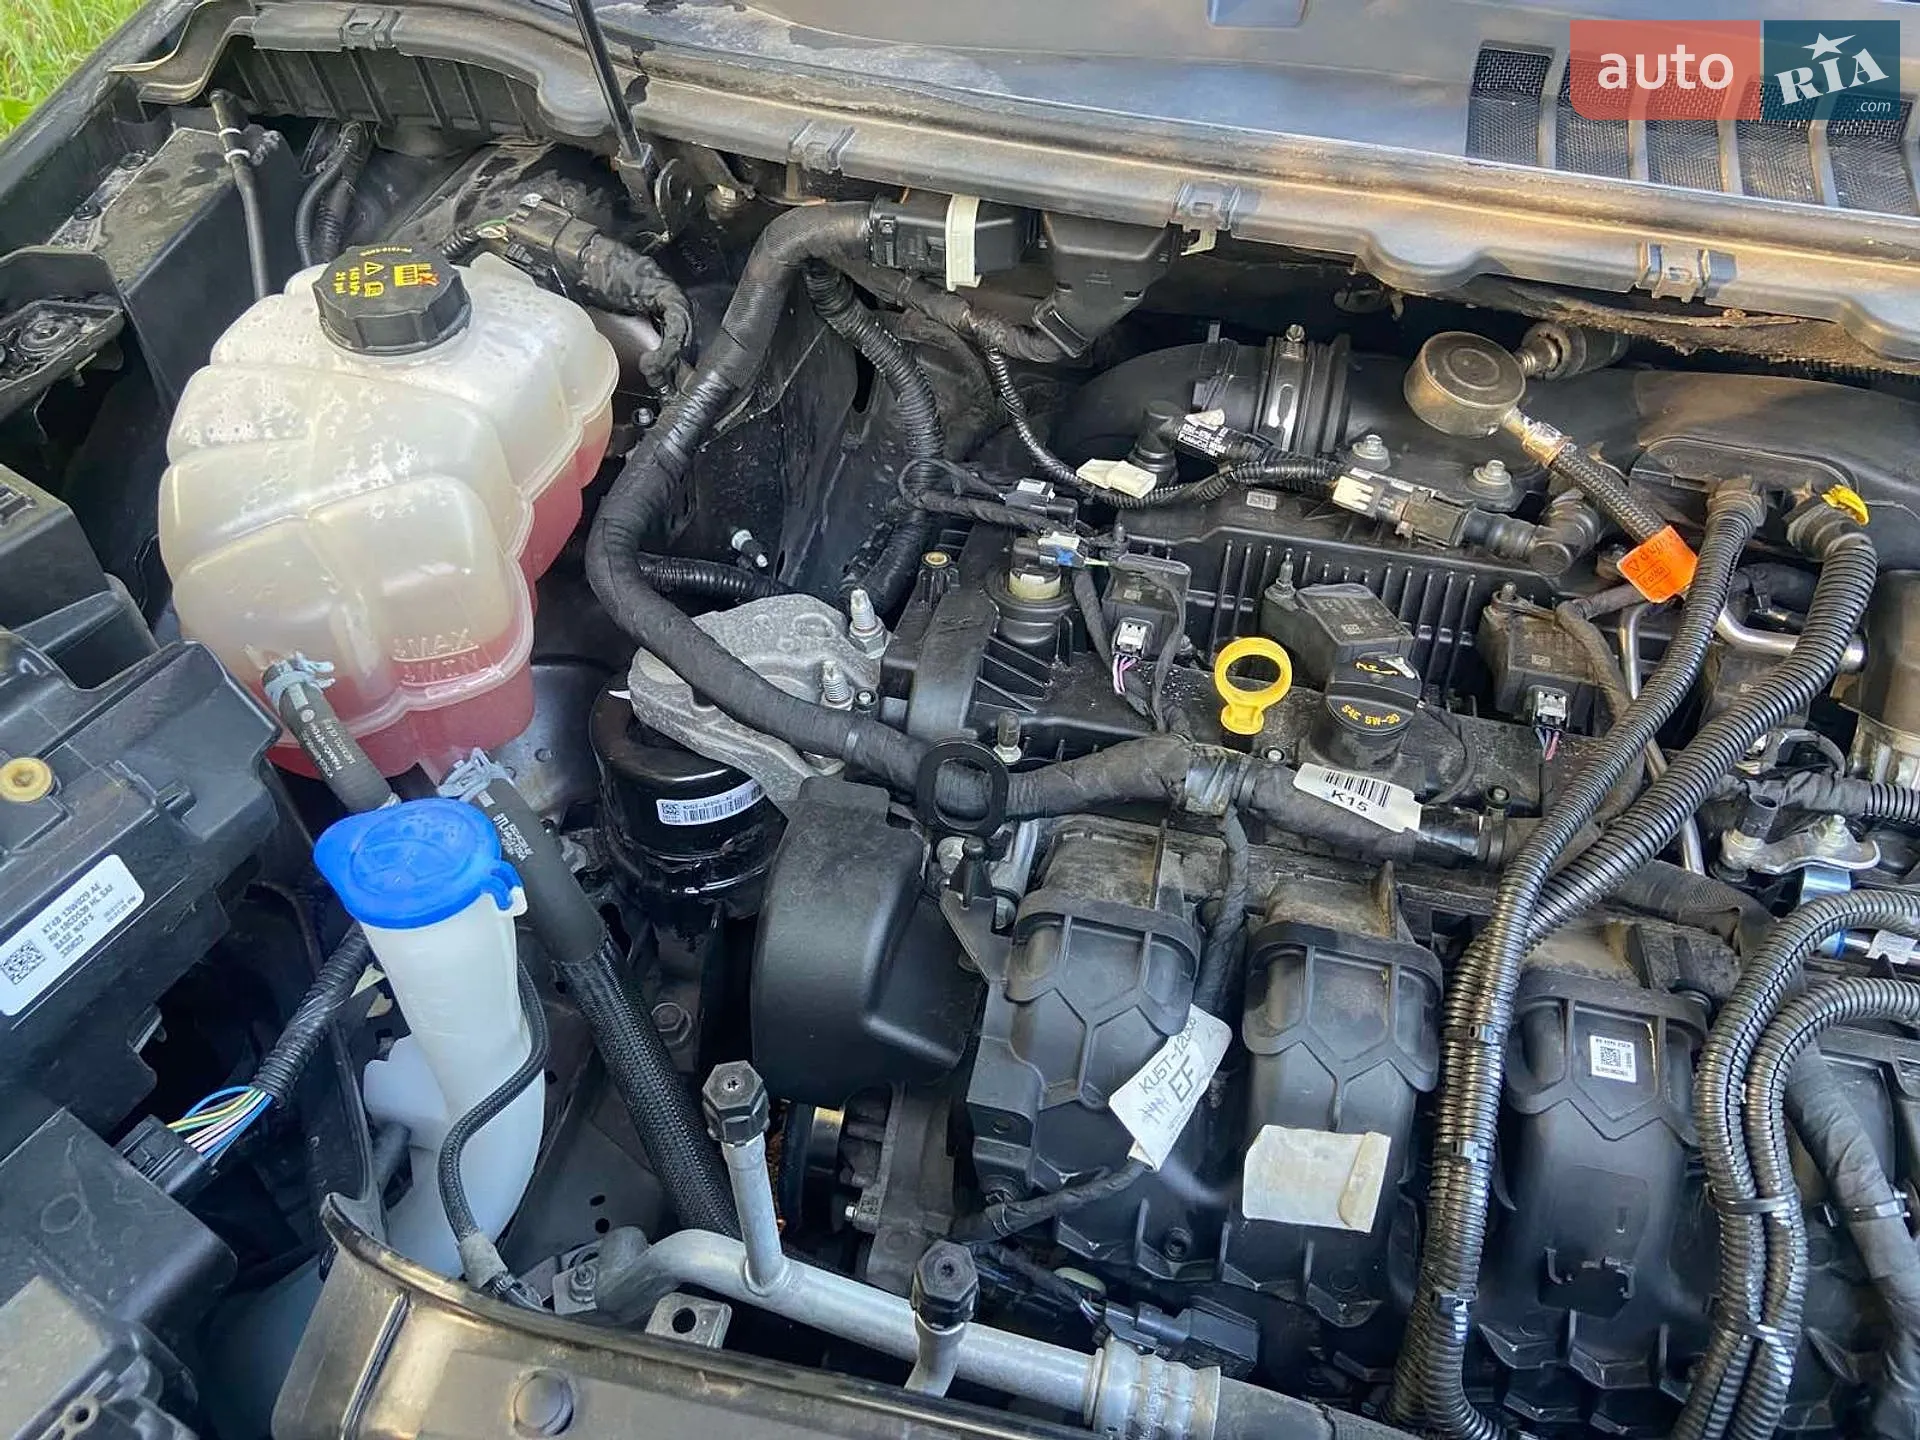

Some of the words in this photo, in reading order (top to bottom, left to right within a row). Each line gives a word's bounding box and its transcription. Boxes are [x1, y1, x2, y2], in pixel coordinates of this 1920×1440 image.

[1341, 704, 1362, 721] SAE
[1331, 789, 1369, 812] K15
[1168, 1055, 1194, 1103] EF
